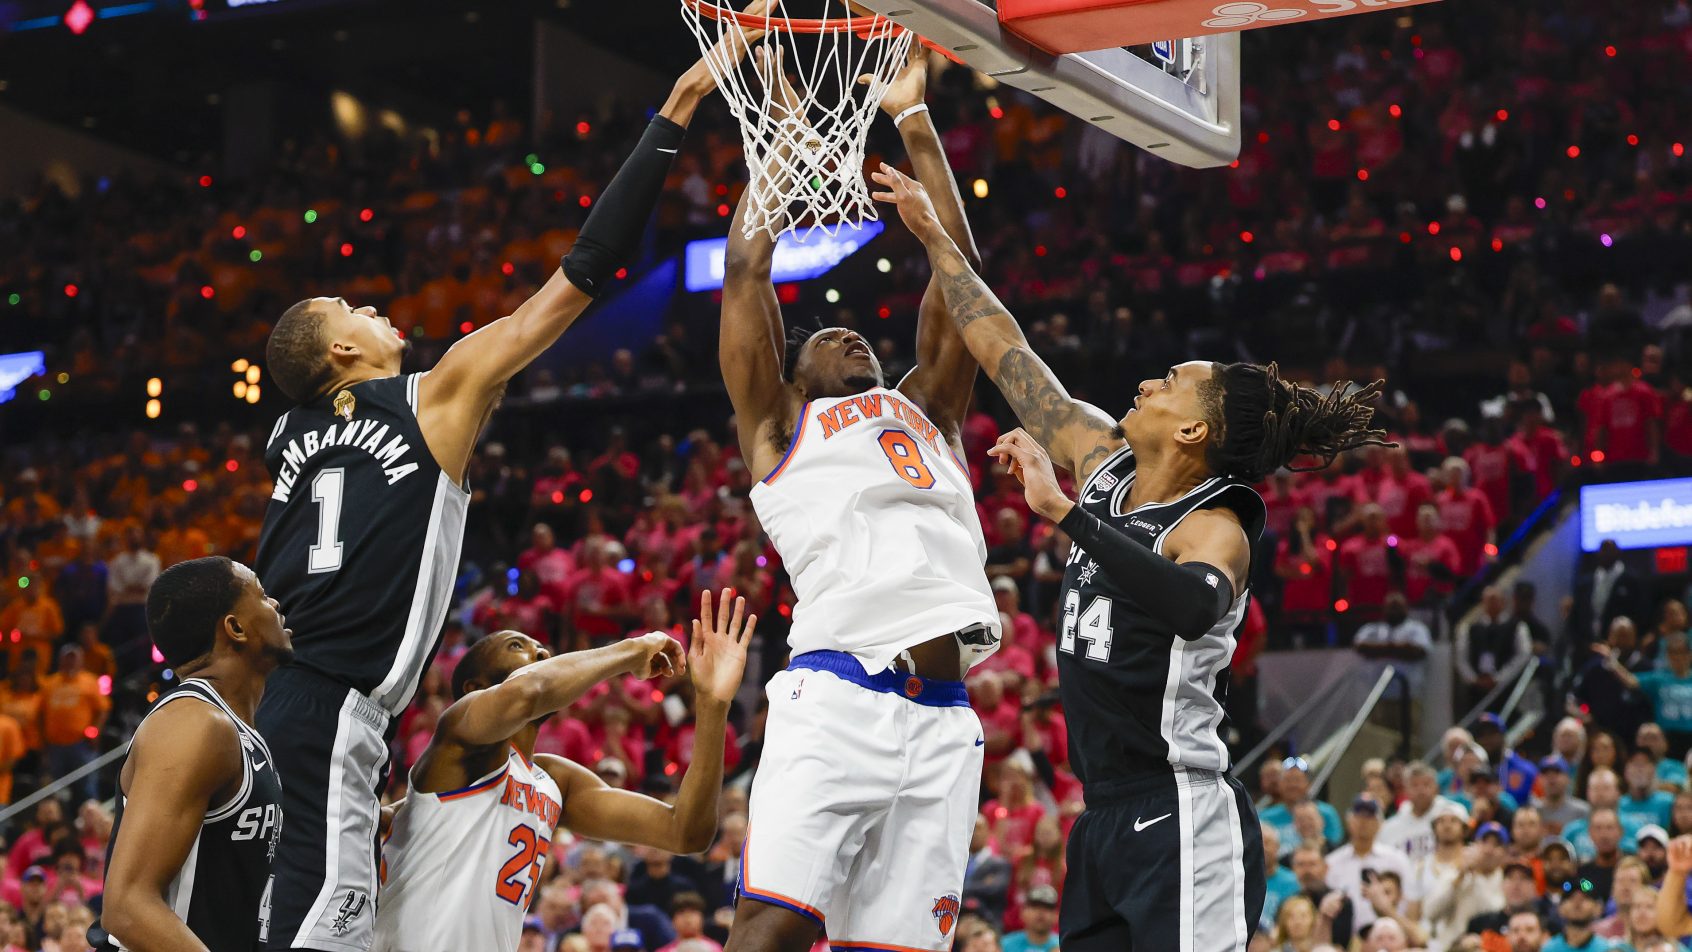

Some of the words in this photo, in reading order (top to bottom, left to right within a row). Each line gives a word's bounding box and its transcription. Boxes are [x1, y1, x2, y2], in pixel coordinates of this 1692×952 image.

[817, 394, 882, 440] NEW
[883, 394, 941, 457] YORK
[876, 429, 937, 489] 8
[271, 419, 419, 503] WEMBANYAMA
[308, 467, 345, 574] 1
[1130, 519, 1156, 531] LEDGER
[1059, 588, 1114, 663] 24
[500, 775, 538, 817] NEW
[496, 823, 551, 912] 25
[258, 874, 276, 943] 4
